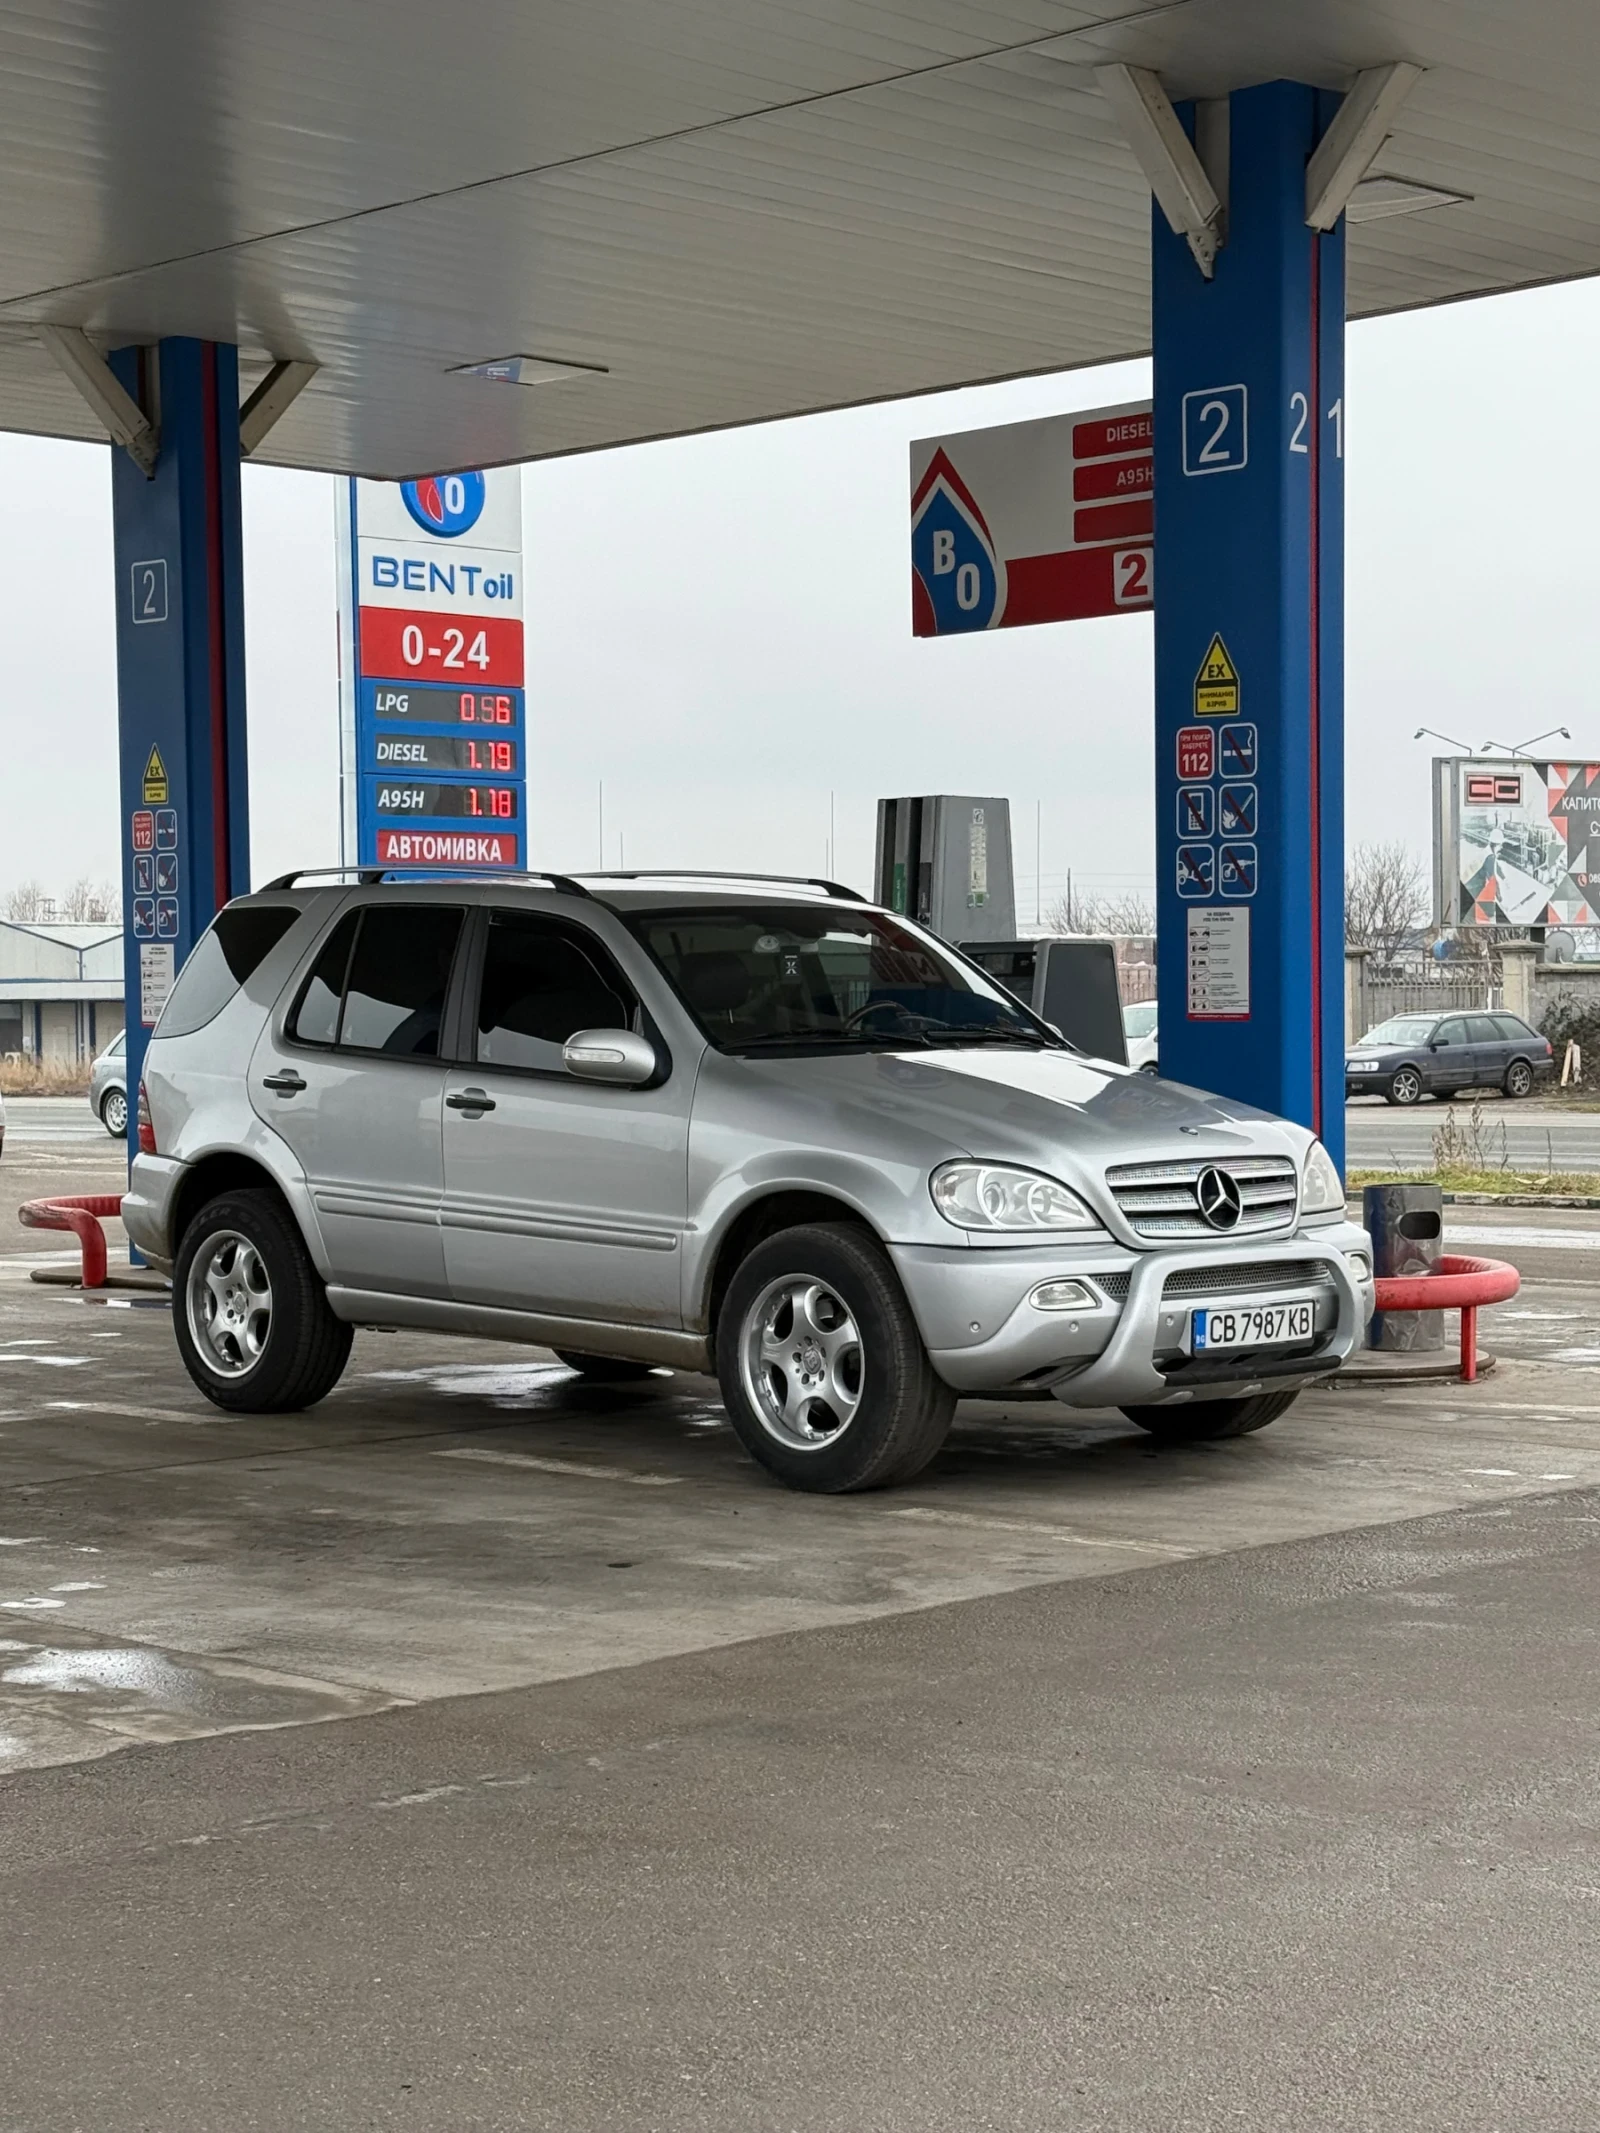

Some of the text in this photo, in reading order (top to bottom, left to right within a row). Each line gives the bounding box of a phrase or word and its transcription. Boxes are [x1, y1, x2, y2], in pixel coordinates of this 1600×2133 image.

[1199, 400, 1230, 463] 2
[1289, 391, 1343, 459] 2 1
[143, 569, 156, 614] 2
[1120, 554, 1148, 599] 2
[402, 625, 490, 670] 0-24
[1207, 664, 1225, 678] EX
[376, 693, 511, 723] LPG 0.56
[150, 766, 160, 776] EX
[377, 742, 511, 771] DIESEL 1.19
[1182, 753, 1209, 772] 112
[378, 788, 511, 818] A95H 1.18
[135, 831, 151, 845] 112
[386, 835, 502, 862] АВТОМИВКА
[1210, 1307, 1309, 1343] CB 7987 KB
